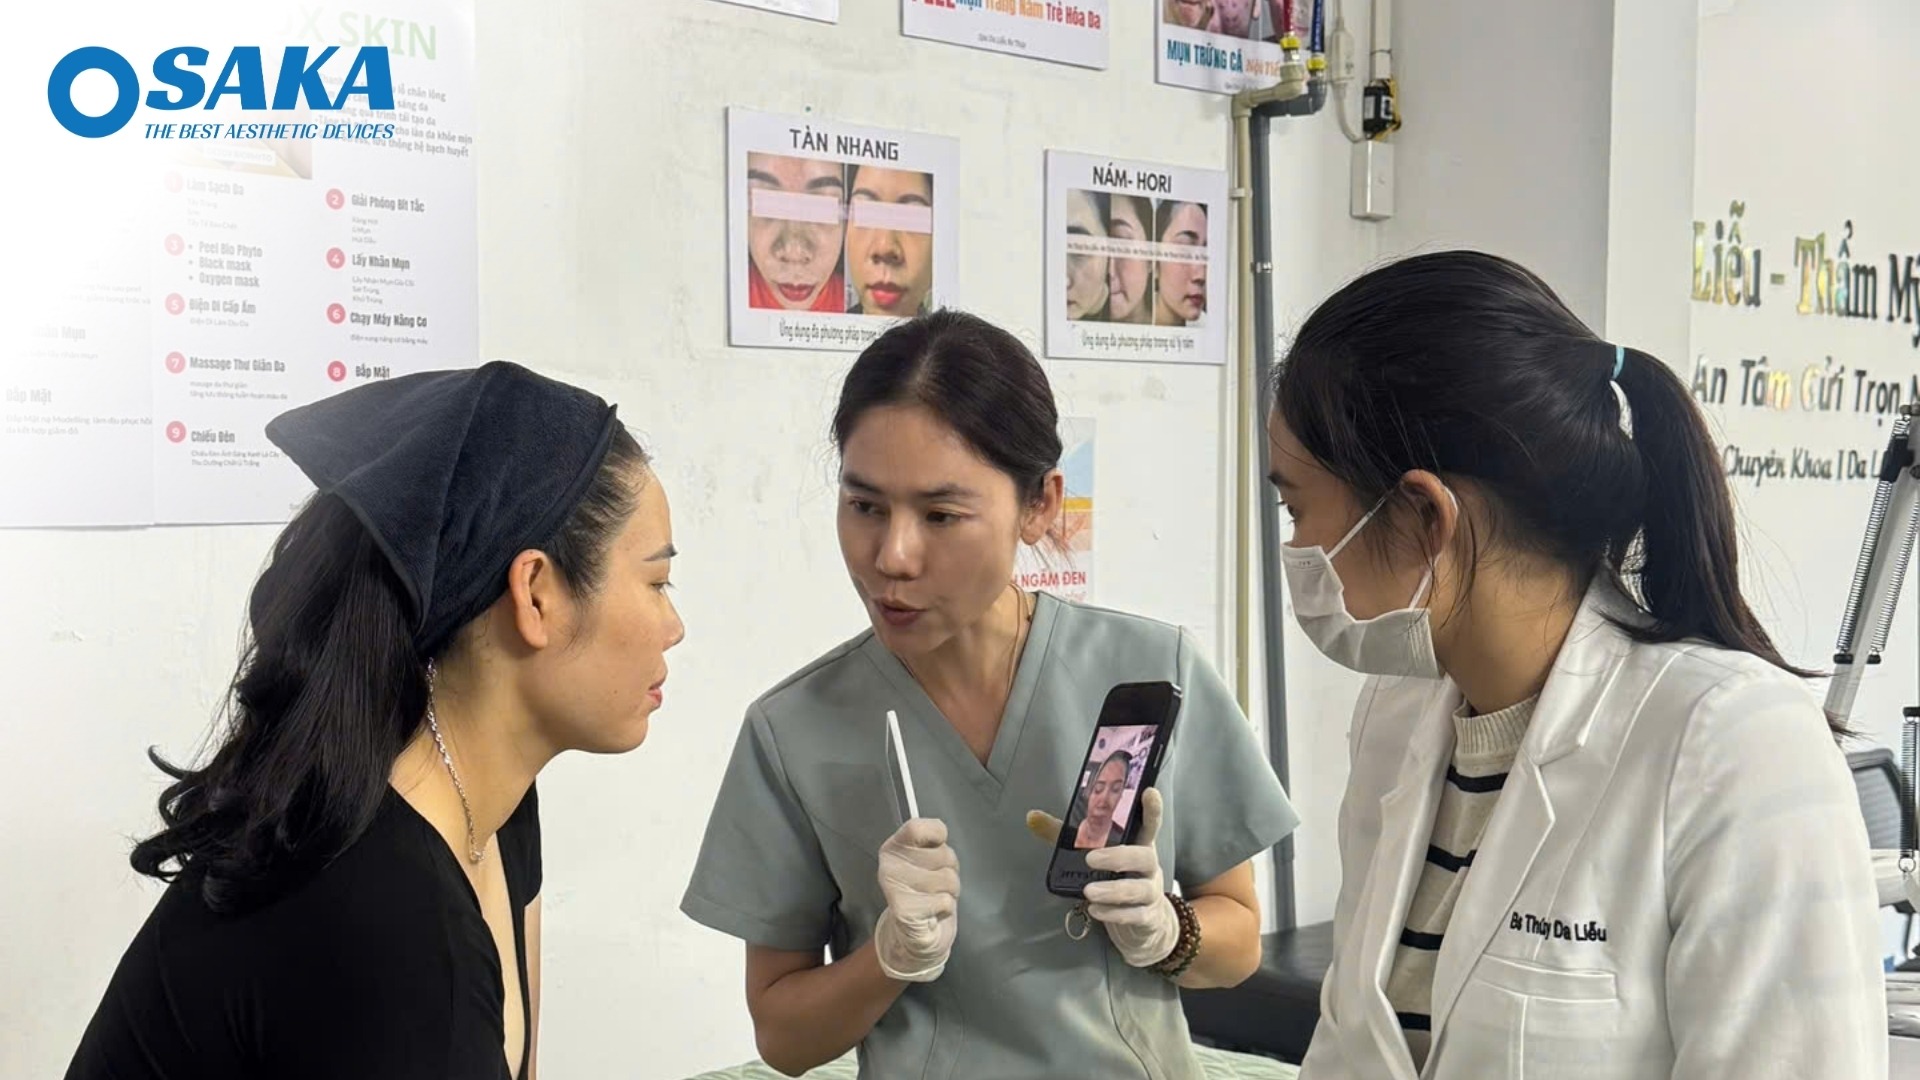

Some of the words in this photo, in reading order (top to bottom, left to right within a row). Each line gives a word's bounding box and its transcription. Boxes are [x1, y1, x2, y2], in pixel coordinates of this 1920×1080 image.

[1065, 5, 1085, 27] Hóa
[1088, 10, 1101, 29] Da
[1167, 39, 1191, 66] MỤN
[1230, 48, 1243, 73] CÁ
[789, 125, 828, 153] TÀN
[836, 134, 899, 161] NHANG
[1137, 171, 1172, 193] HORI
[199, 241, 219, 254] Peel
[221, 243, 235, 255] Bio
[237, 244, 263, 258] Phyto
[199, 256, 224, 270] Black
[226, 259, 252, 273] mask
[352, 252, 368, 267] Lấy
[392, 257, 410, 272] Mụn
[1691, 200, 1761, 308] Liễu
[1793, 219, 1878, 320] Thẩm
[199, 272, 233, 287] Oxygen
[235, 275, 261, 288] mask
[350, 312, 372, 327] Chạy
[373, 312, 392, 327] Máy
[61, 325, 86, 342] Mụn
[190, 356, 232, 372] Massage
[30, 387, 52, 406] Mặt
[1854, 369, 1901, 427] Trọn
[191, 428, 217, 444] Chiếu
[1790, 447, 1833, 480] Khoa
[1847, 450, 1867, 480] Da
[1062, 570, 1086, 585] ĐEN
[1525, 913, 1552, 941] Thúy
[1553, 919, 1572, 941] Da
[1574, 921, 1607, 942] Liễu
